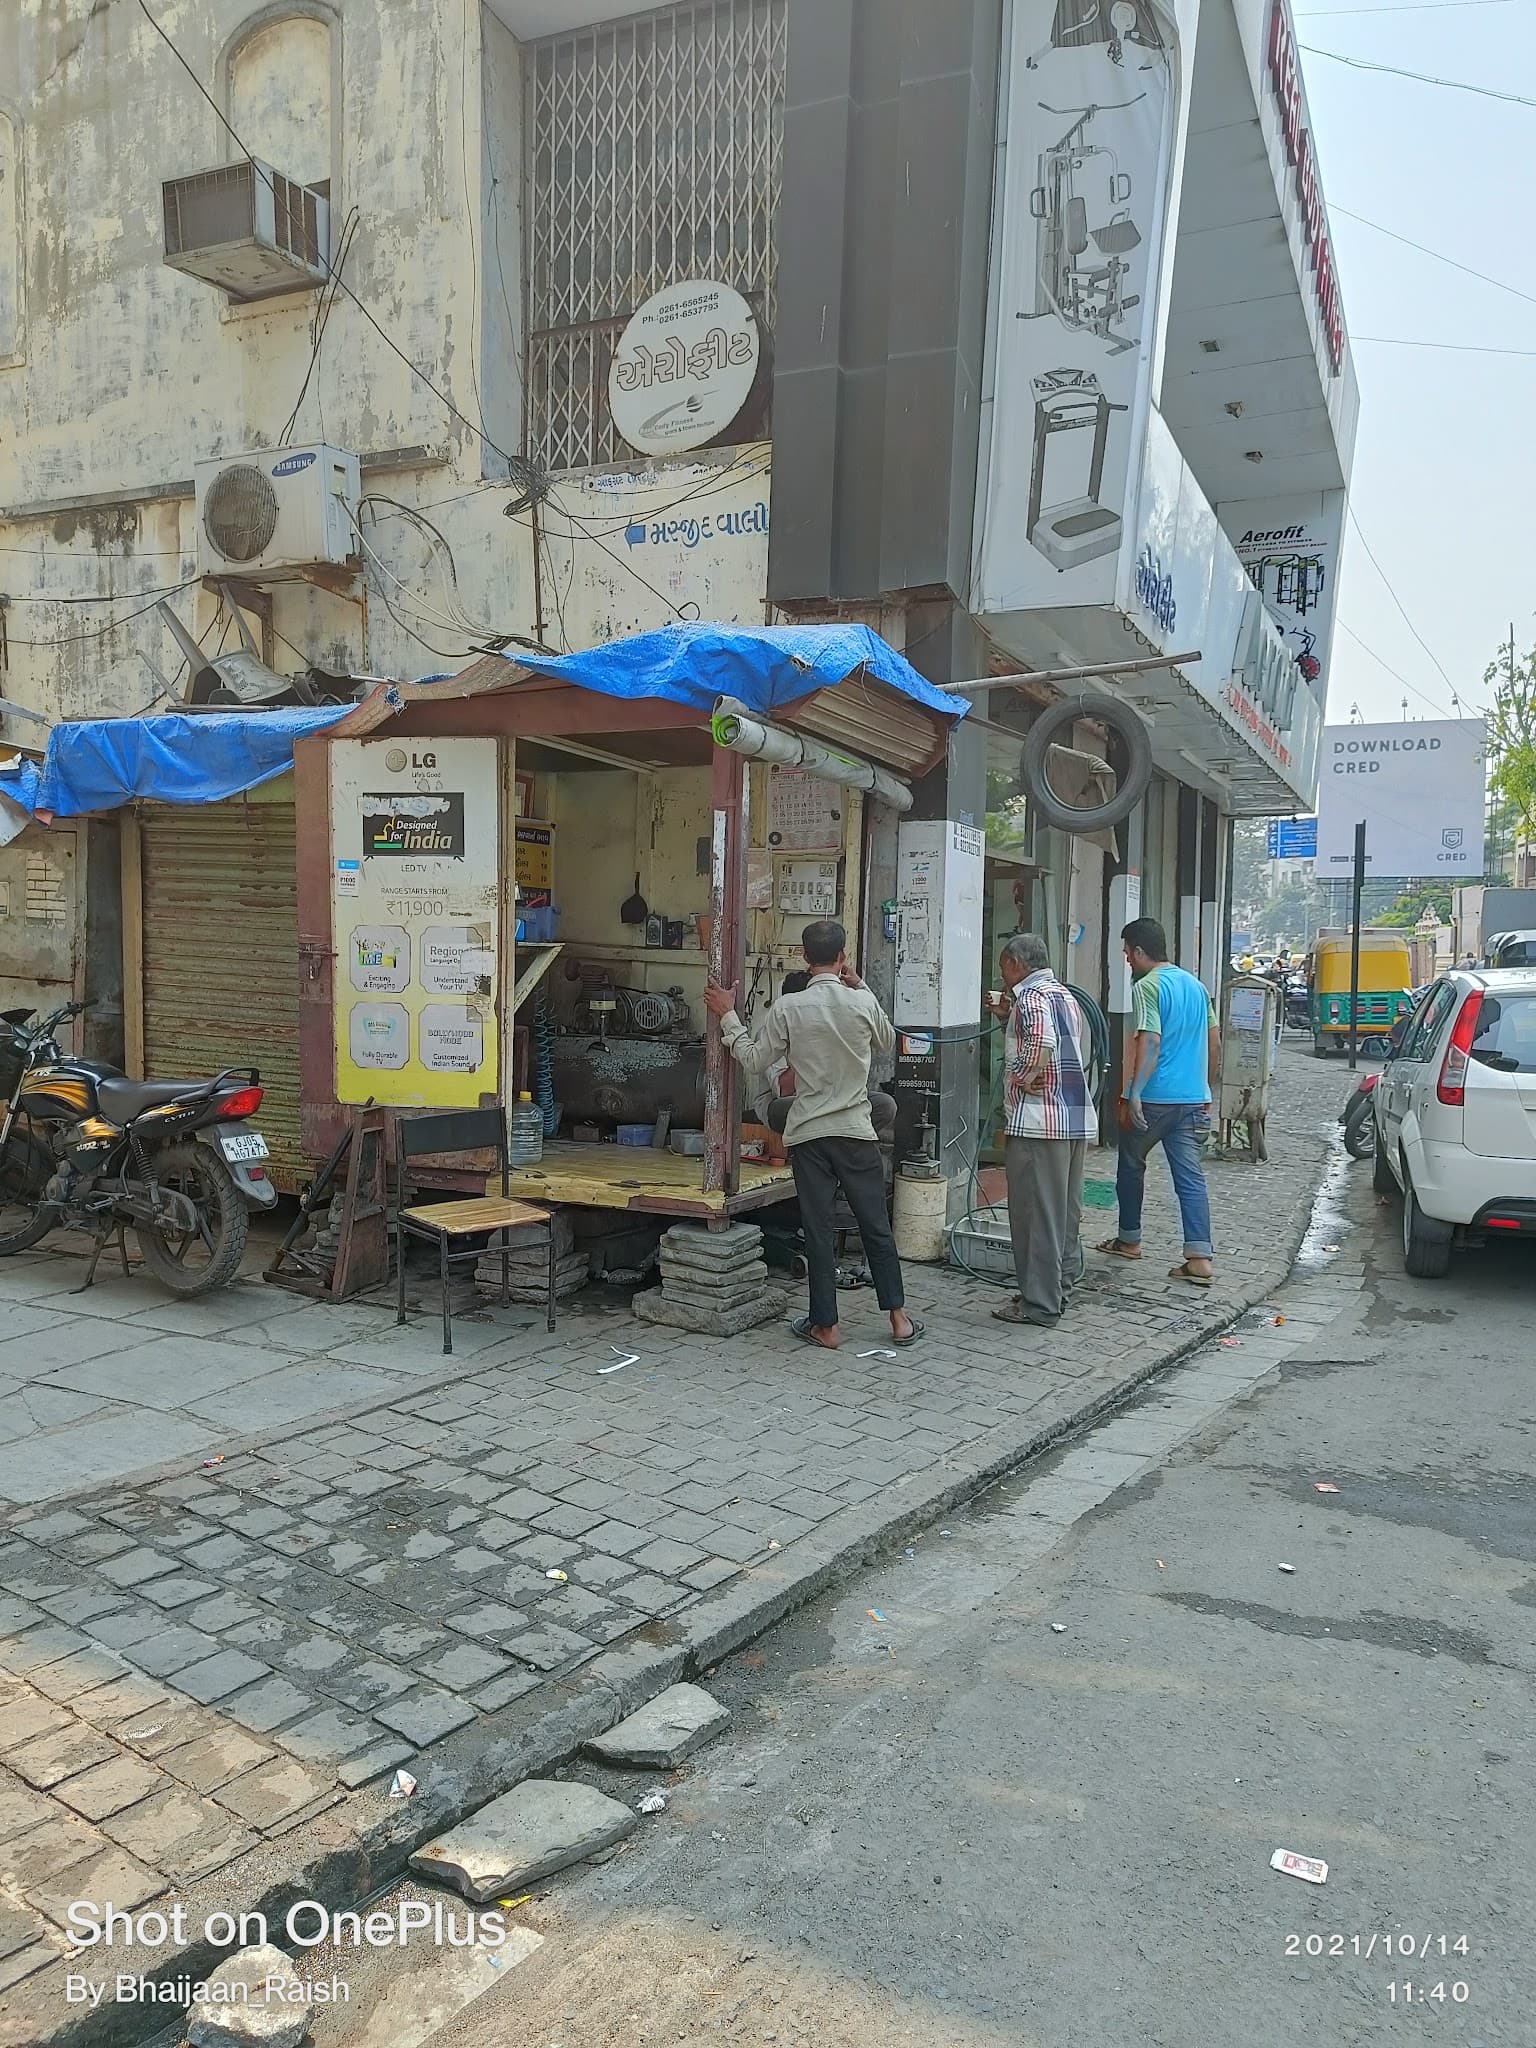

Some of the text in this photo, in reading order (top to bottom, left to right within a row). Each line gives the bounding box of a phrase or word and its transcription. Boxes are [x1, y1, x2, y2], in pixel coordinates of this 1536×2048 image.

[659, 292, 719, 315] 0261-6565245
[659, 302, 719, 324] 0261-6537793
[616, 327, 753, 391] એરોફીટ
[276, 458, 312, 471] SAMSUNG
[1240, 525, 1305, 543] Aerofit
[1333, 738, 1441, 754] DOWNLOAD
[412, 753, 436, 769] LG
[1333, 761, 1380, 774] CRED
[396, 820, 437, 831] Designed
[390, 830, 453, 849] for India
[1437, 853, 1467, 861] CRED
[386, 900, 443, 917] ₹11,900
[235, 1136, 258, 1148] GJ05
